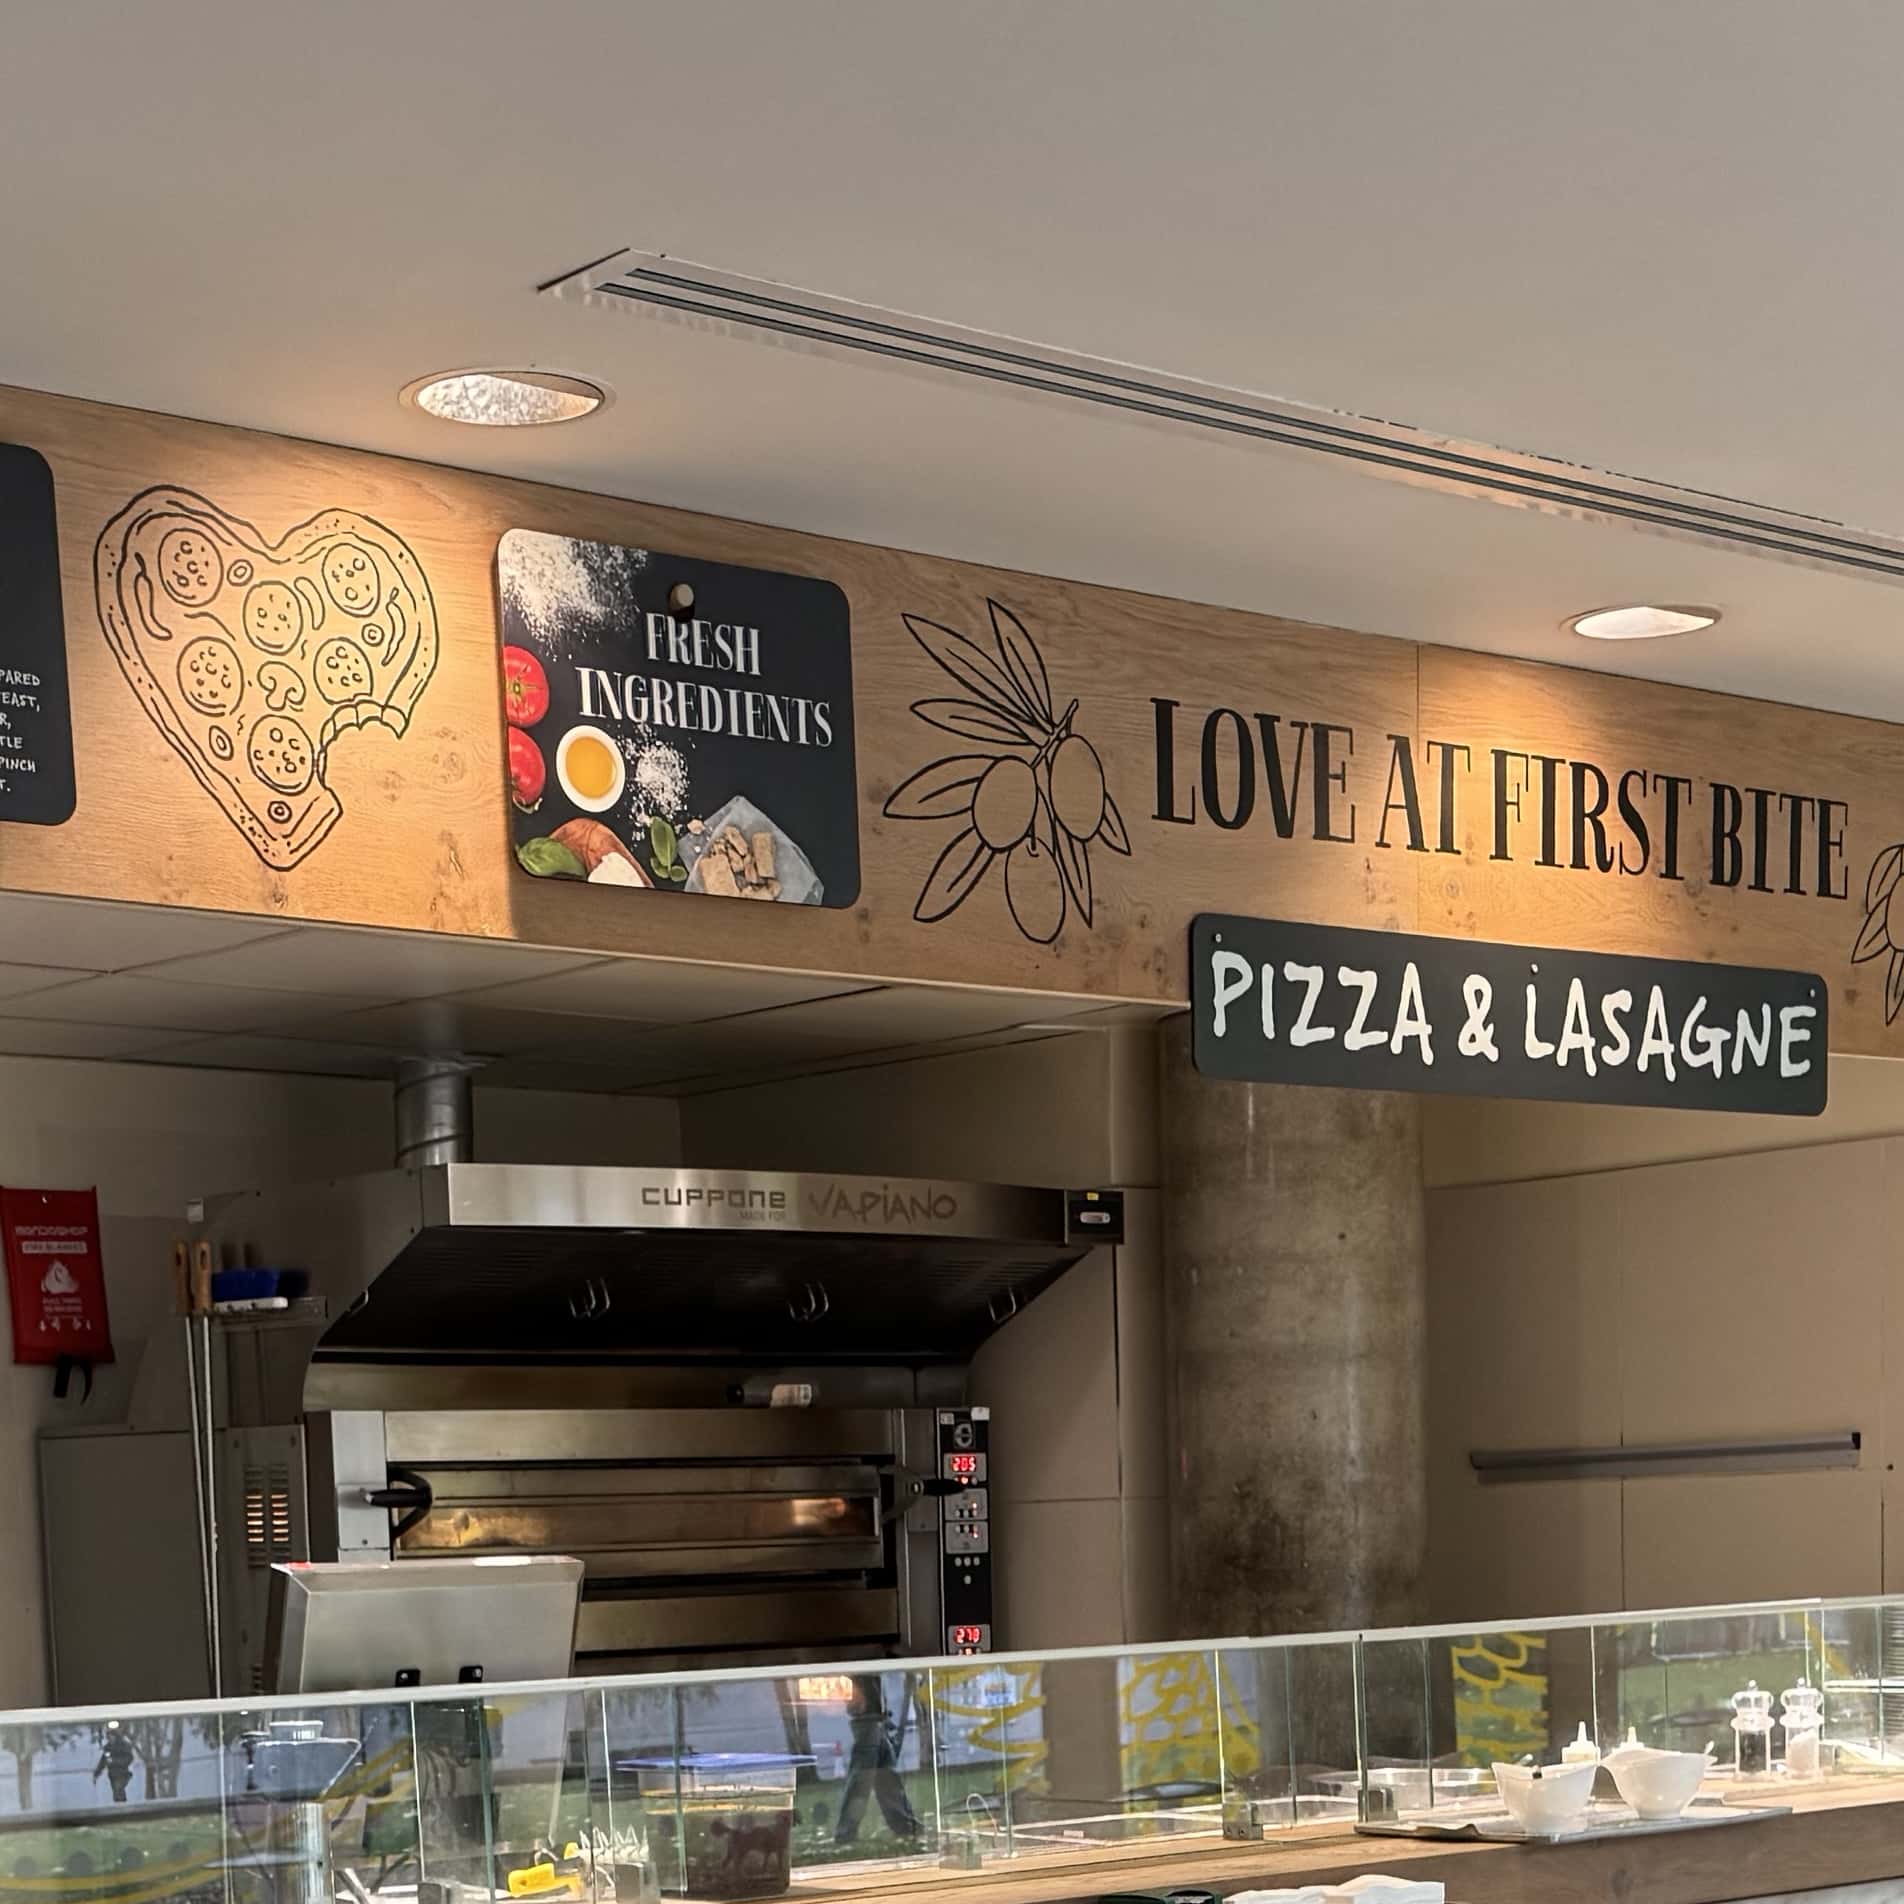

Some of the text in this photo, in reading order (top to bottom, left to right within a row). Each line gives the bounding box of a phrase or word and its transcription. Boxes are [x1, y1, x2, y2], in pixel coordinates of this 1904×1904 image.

[647, 613, 760, 675] FRESH
[575, 667, 831, 748] INGREDIENTS
[1151, 698, 1848, 899] LOVE AT FIRST BITE
[1212, 950, 1817, 1082] PIZZA & LASAGNE
[952, 1456, 976, 1472] 205
